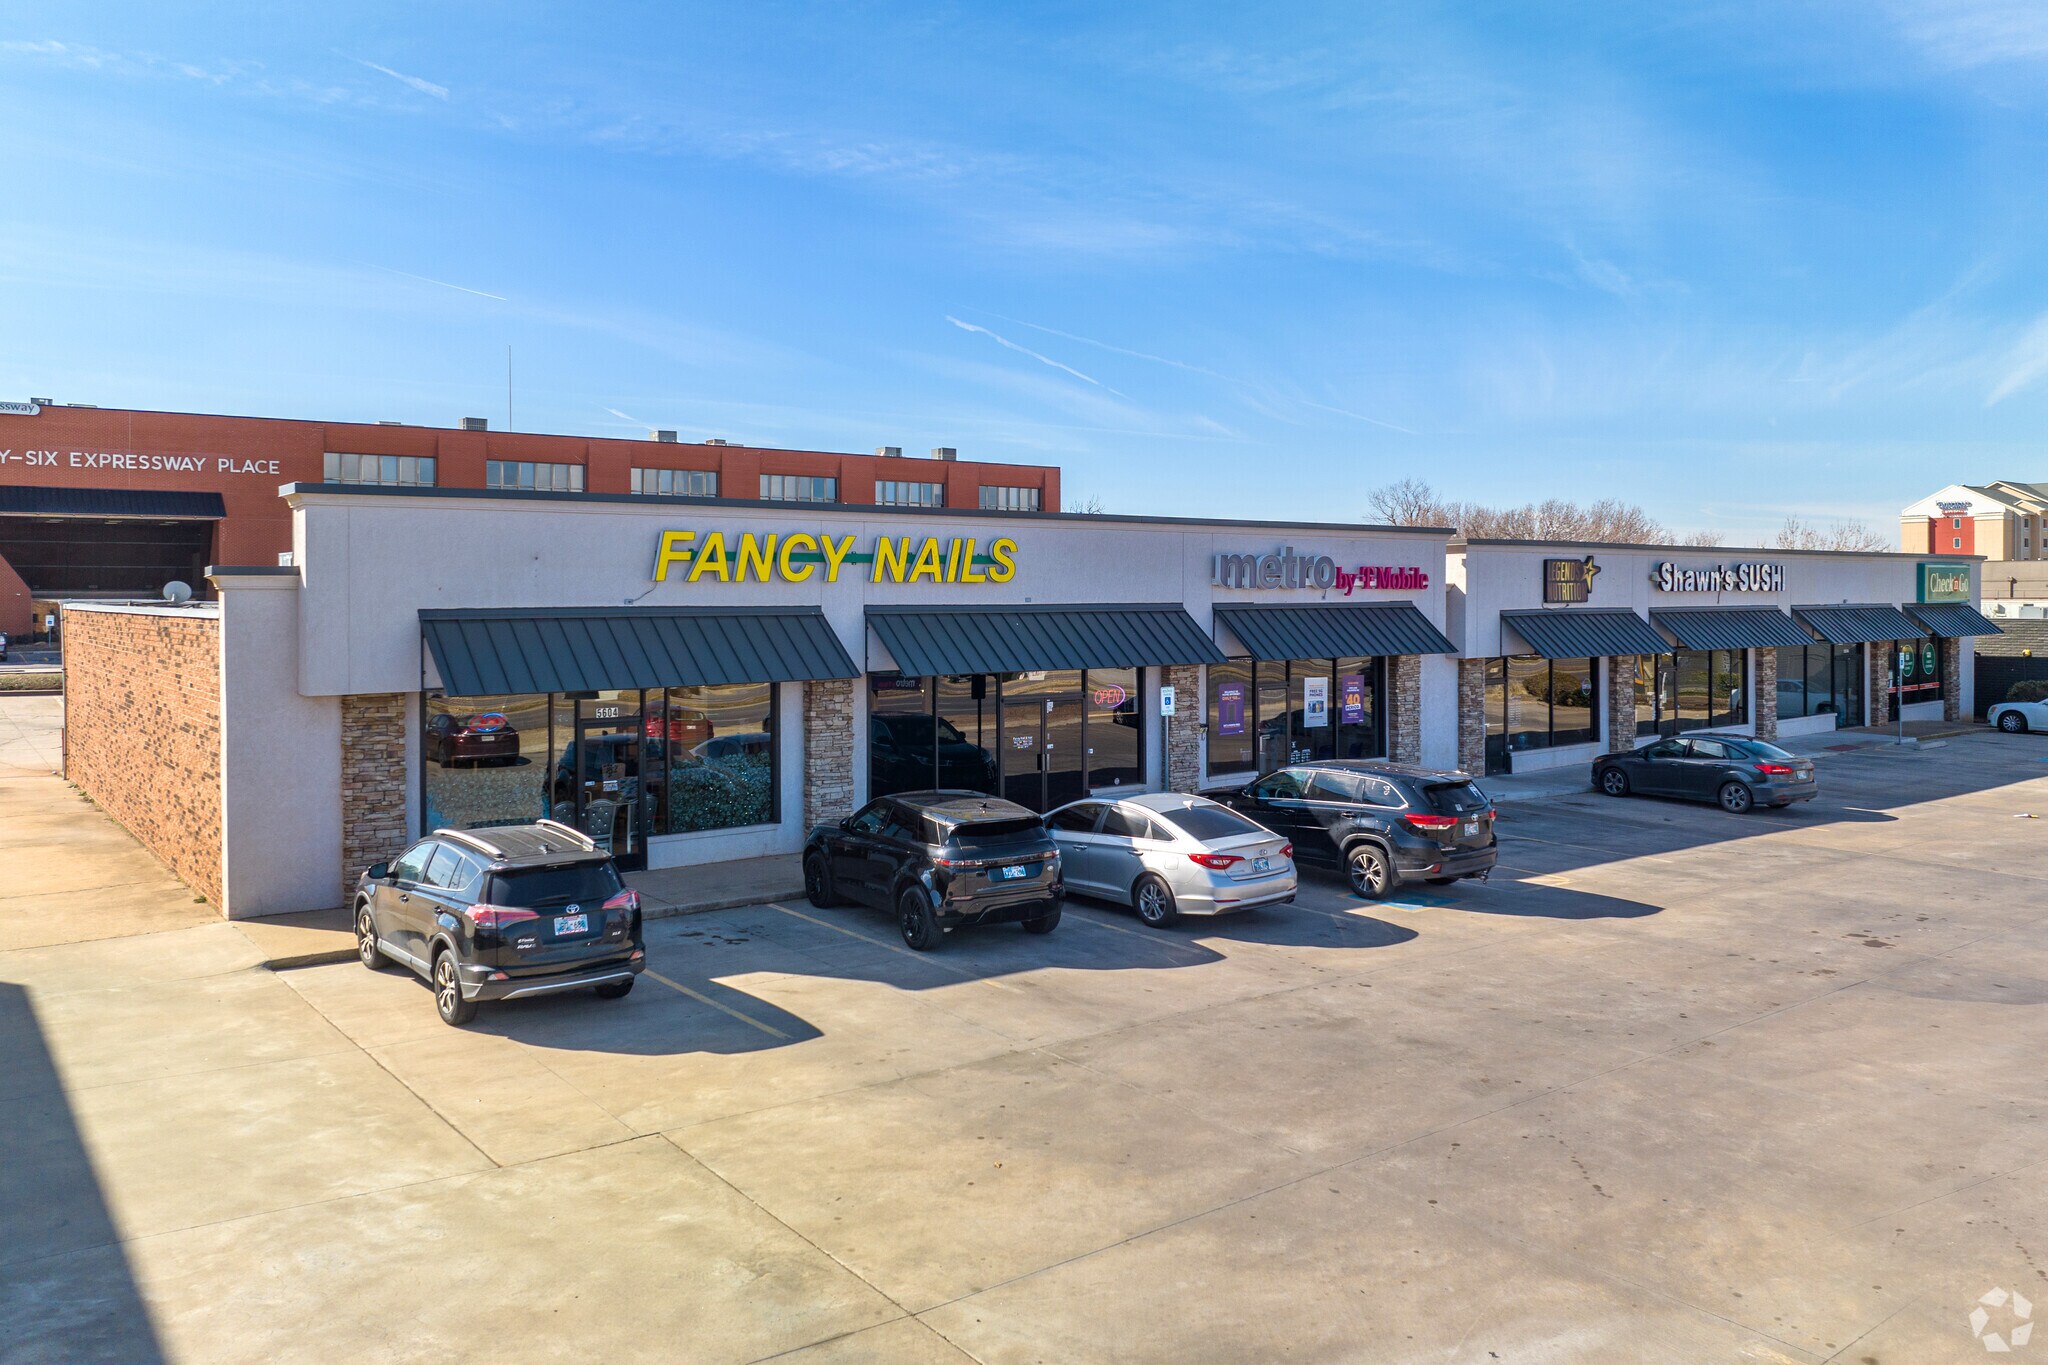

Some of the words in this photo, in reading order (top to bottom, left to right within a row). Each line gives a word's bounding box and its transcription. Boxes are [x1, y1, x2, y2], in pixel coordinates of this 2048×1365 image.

[70, 452, 206, 471] EXPRESSWAY
[218, 458, 280, 475] PLACE
[652, 530, 857, 583] FANCY
[869, 536, 1018, 584] NAILS
[1213, 546, 1336, 590] metro
[1336, 566, 1356, 596] by
[1550, 561, 1581, 581] EGENDS
[1658, 562, 1734, 592] Shawn's
[1736, 563, 1786, 592] SUSHI
[1931, 573, 1953, 592] Check
[1960, 573, 1968, 592] Go
[1094, 689, 1120, 705] OPEN
[597, 708, 618, 718] 5604
